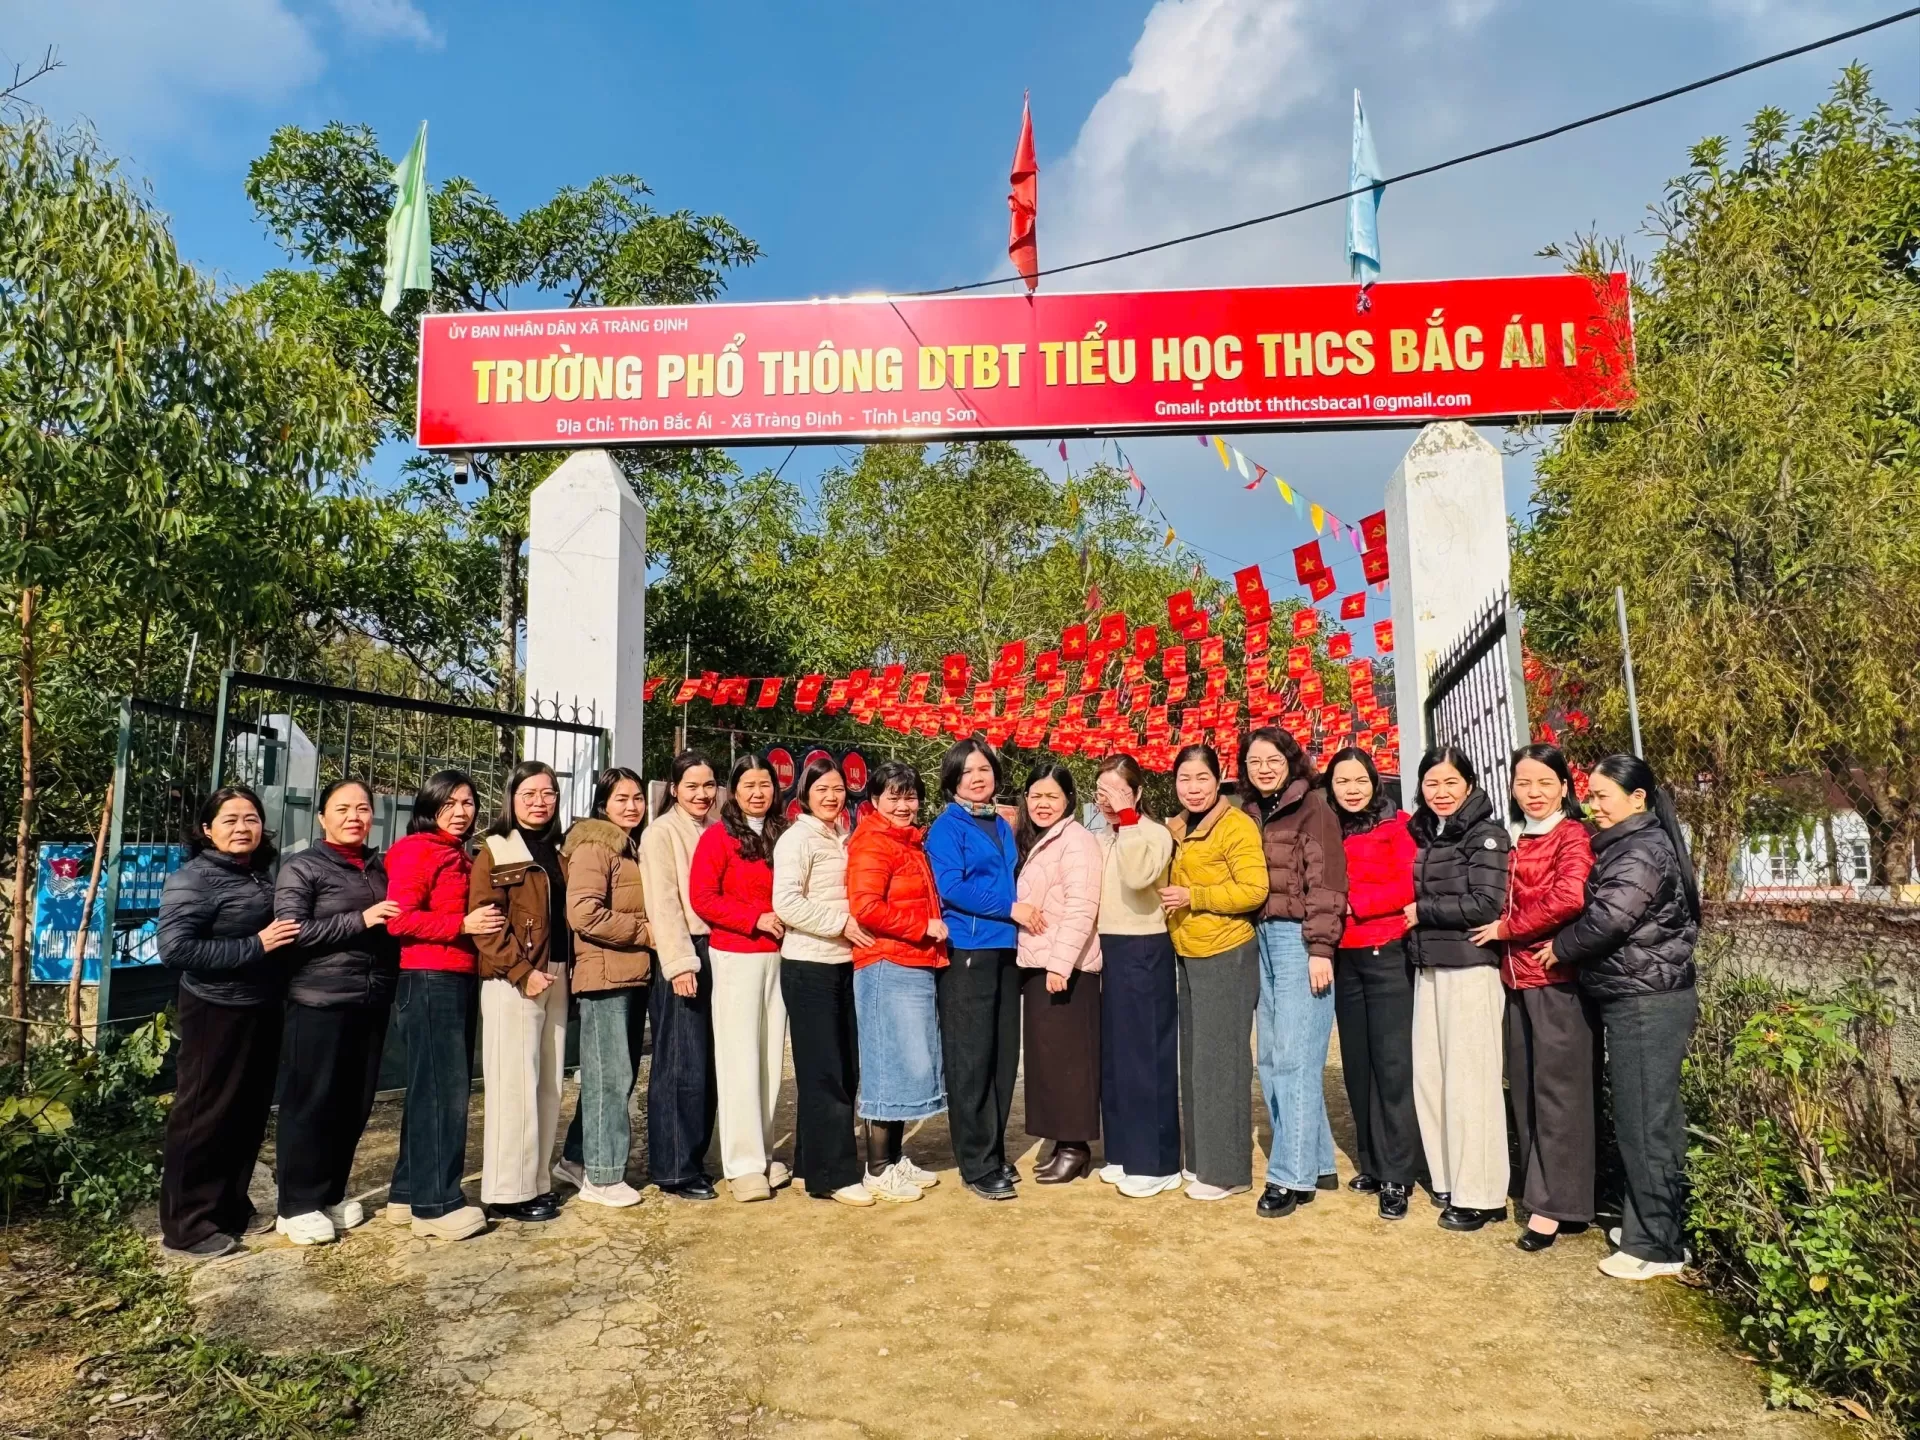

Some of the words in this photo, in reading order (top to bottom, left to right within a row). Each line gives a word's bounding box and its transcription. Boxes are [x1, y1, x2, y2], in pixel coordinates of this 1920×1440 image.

[448, 321, 468, 339] ỦY
[471, 325, 500, 339] BAN
[503, 320, 544, 337] NHÂN
[547, 319, 576, 335] DÂN
[580, 318, 600, 334] XÃ
[603, 317, 650, 333] TRÀNG
[653, 318, 688, 334] ĐỊNH
[472, 343, 643, 404] TRƯỜNG
[657, 332, 746, 399] PHỔ
[758, 339, 903, 396] THÔNG
[918, 343, 1026, 391] DTBT
[1039, 320, 1137, 386] TIỂU
[1152, 334, 1243, 391] HỌC
[1256, 329, 1376, 378] THCS
[1390, 307, 1485, 373] BẮC
[1499, 313, 1547, 369] ÁI
[1560, 322, 1578, 367] I
[1155, 400, 1205, 416] Gmail:
[1208, 399, 1261, 417] ptdtbt
[556, 418, 581, 435] Địa
[585, 415, 615, 432] Chỉ:
[618, 416, 659, 432] Thôn
[663, 412, 692, 430] Bắc
[731, 413, 752, 429] Xã
[755, 412, 801, 429] Tràng
[805, 411, 842, 428] Định
[862, 407, 897, 425] Tỉnh
[903, 409, 941, 427] Lạng
[946, 407, 977, 422] Sơn
